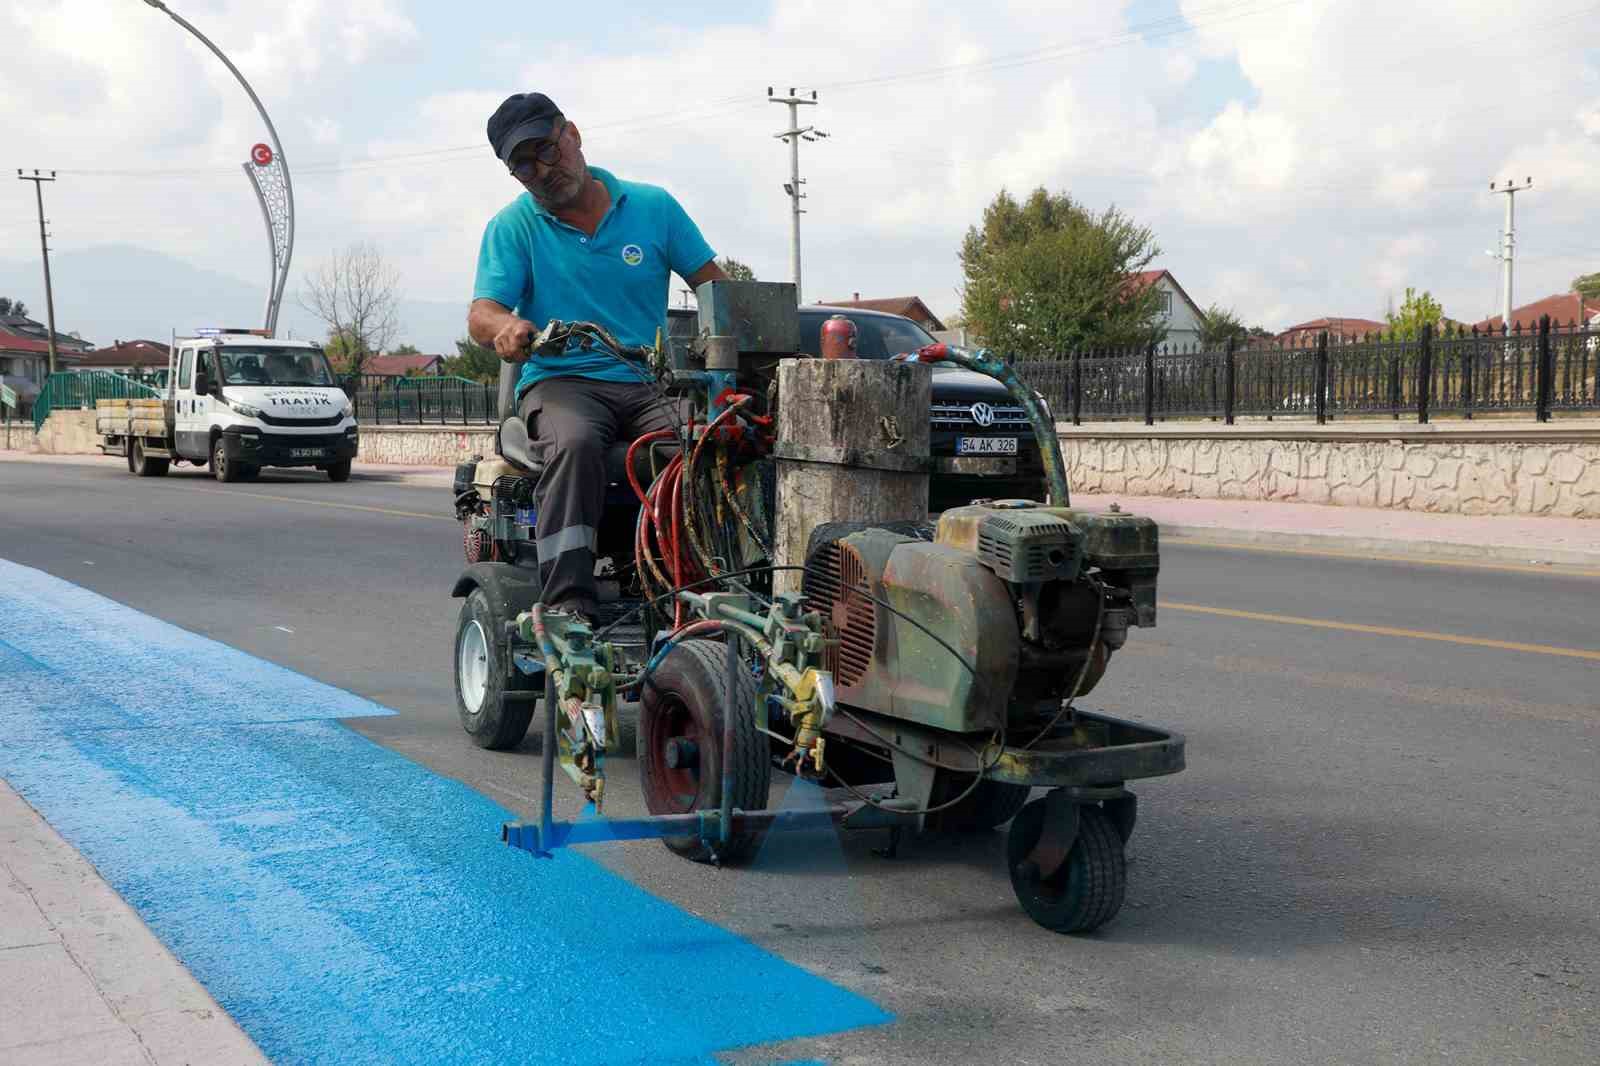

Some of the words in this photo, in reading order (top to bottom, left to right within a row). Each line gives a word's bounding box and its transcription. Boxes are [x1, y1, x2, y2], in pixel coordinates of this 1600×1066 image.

[270, 396, 332, 406] TRAFİK
[979, 438, 993, 451] AK
[998, 439, 1016, 451] 326
